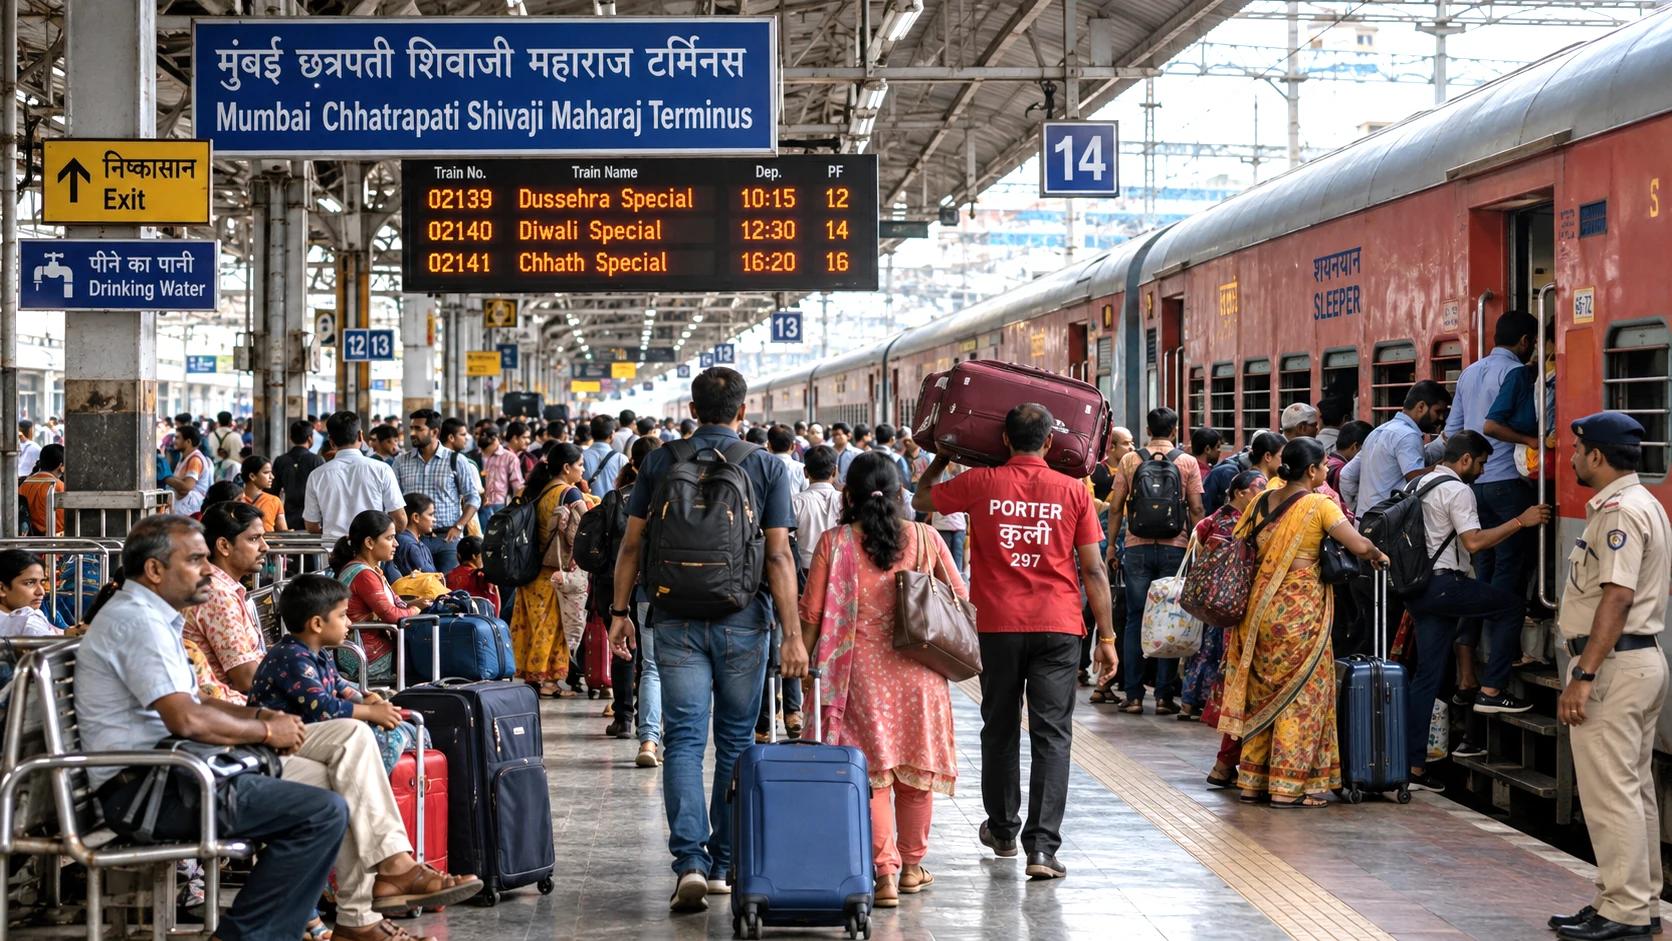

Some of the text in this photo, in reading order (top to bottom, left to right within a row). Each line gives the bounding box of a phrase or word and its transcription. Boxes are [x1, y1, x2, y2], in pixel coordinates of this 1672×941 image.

[215, 35, 747, 91] मुंबई छत्रपती शिवाजी महाराज टर्मिनस
[217, 99, 753, 138] Mumbai Chhatrapati Shivaji Maharaj Terminus
[1055, 135, 1107, 180] 14
[434, 165, 844, 182] Train No. Train Name Dep. PF
[104, 187, 146, 210] Exit
[428, 187, 849, 213] 02139 Dussehra Special 10:15 12
[428, 219, 849, 245] 02140 Diwali Special 12:30 14
[88, 250, 195, 273] पीने का पानी
[428, 251, 849, 277] 02141 Chhath Special 16:20 16
[1313, 246, 1362, 282] शयनयान
[89, 280, 206, 301] Drinking Water
[1314, 285, 1361, 320] SLEEPER
[775, 317, 798, 338] 13
[347, 334, 365, 356] 12
[371, 334, 390, 356] 13
[989, 499, 1063, 520] PORTER
[999, 520, 1053, 549] कुली
[1010, 552, 1041, 568] 297
